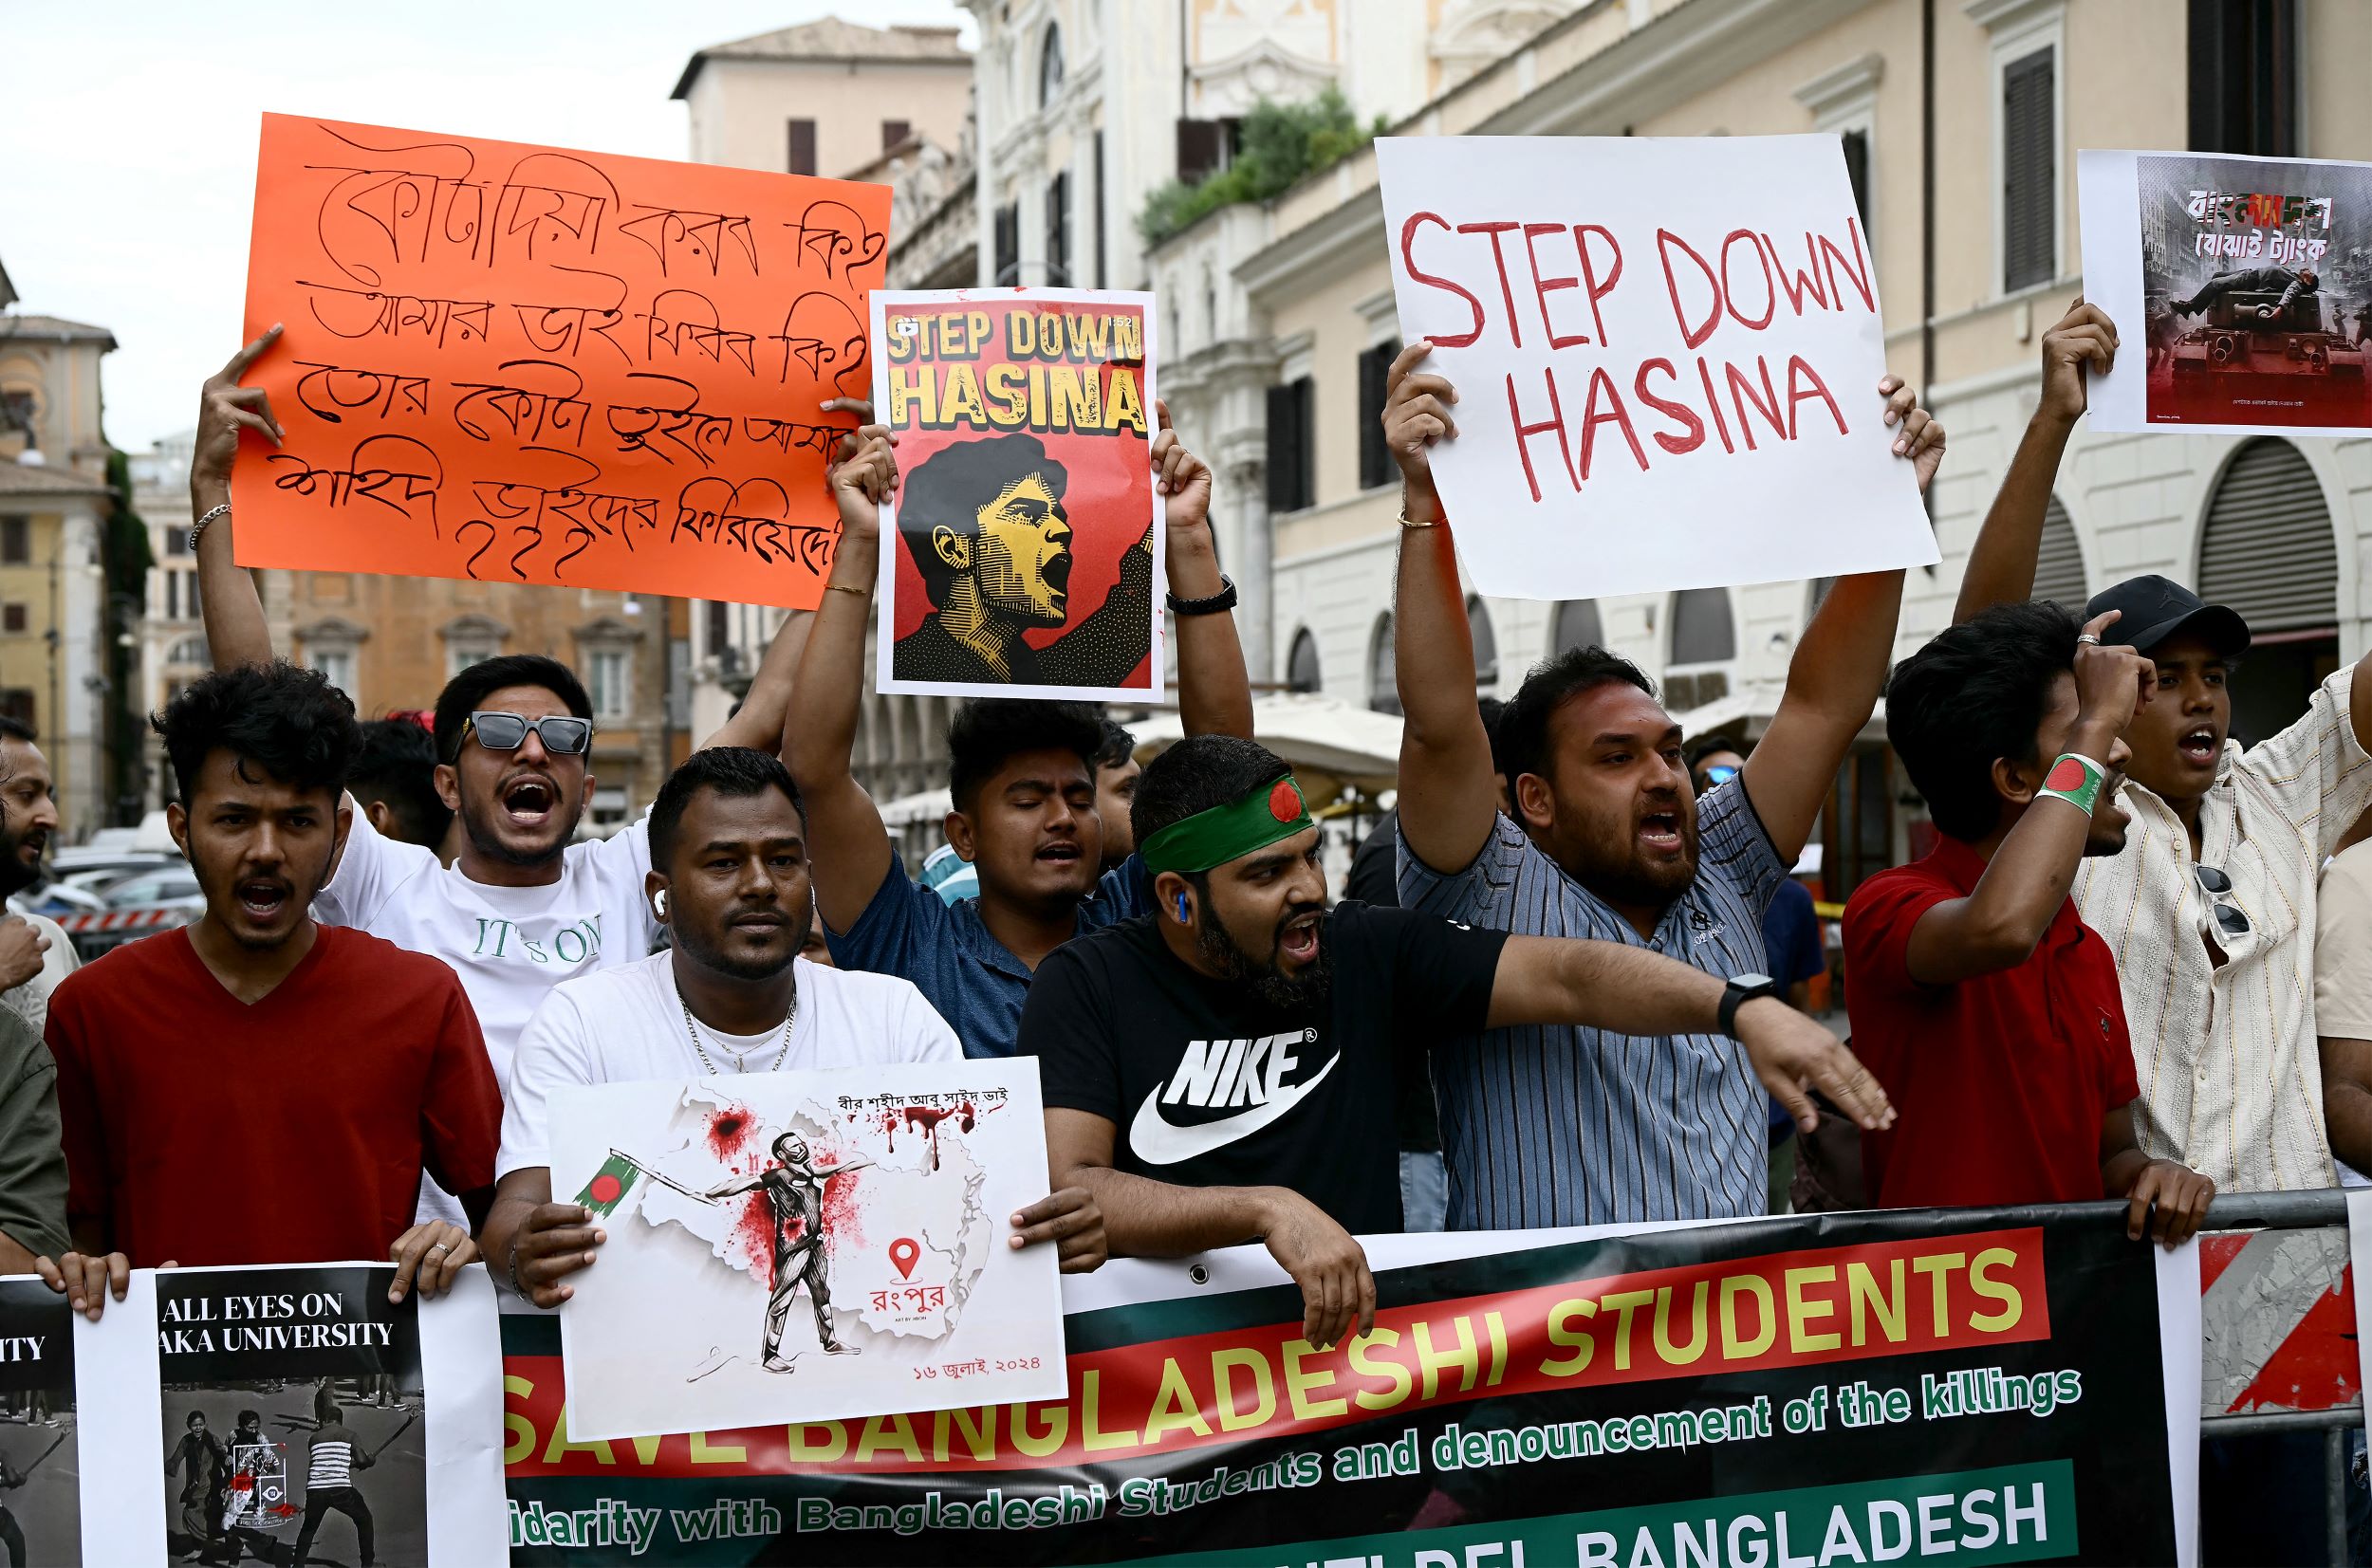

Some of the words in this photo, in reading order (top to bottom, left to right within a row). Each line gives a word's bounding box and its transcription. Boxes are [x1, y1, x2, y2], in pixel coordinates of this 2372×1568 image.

[2188, 190, 2333, 231] বাংলাদেশ
[2196, 228, 2264, 259] বোঝাই
[2270, 229, 2327, 266] ট্যাংক
[1400, 212, 1623, 350] STEP
[1657, 216, 1876, 350] DOWN
[294, 279, 496, 350] আমার
[510, 264, 633, 367] ভাই
[887, 310, 992, 360] STEP
[1009, 309, 1143, 364] DOWN
[292, 360, 431, 423] তোর
[889, 362, 1148, 436] HASINA
[1507, 355, 1850, 504] HASINA
[555, 913, 602, 963] ON
[1161, 1029, 1305, 1108] NIKE
[838, 1096, 864, 1110] বীর
[867, 1093, 905, 1109] শহীদ
[908, 1093, 941, 1108] আবু
[982, 1087, 1009, 1101] ভাই
[162, 1298, 217, 1322] ALL
[224, 1294, 295, 1320] EYES
[301, 1292, 343, 1317] ON
[869, 1286, 946, 1313] রংপুর
[1538, 1247, 2025, 1377] STUDENTS
[223, 1322, 394, 1352] UNIVERSITY
[913, 1366, 936, 1380] ১৬
[941, 1357, 990, 1379] জুলাই,
[995, 1356, 1041, 1373] ২০২৪
[669, 1498, 782, 1542] with
[796, 1483, 1105, 1536] Bangladeshi
[1117, 1448, 1323, 1518] Students
[1333, 1428, 1419, 1482] and
[1433, 1395, 1771, 1472] denouncement
[1784, 1385, 1828, 1434] of
[1837, 1381, 1911, 1428] the
[1920, 1366, 2082, 1419] killings
[1575, 1482, 2048, 1568] BANGLADESH
